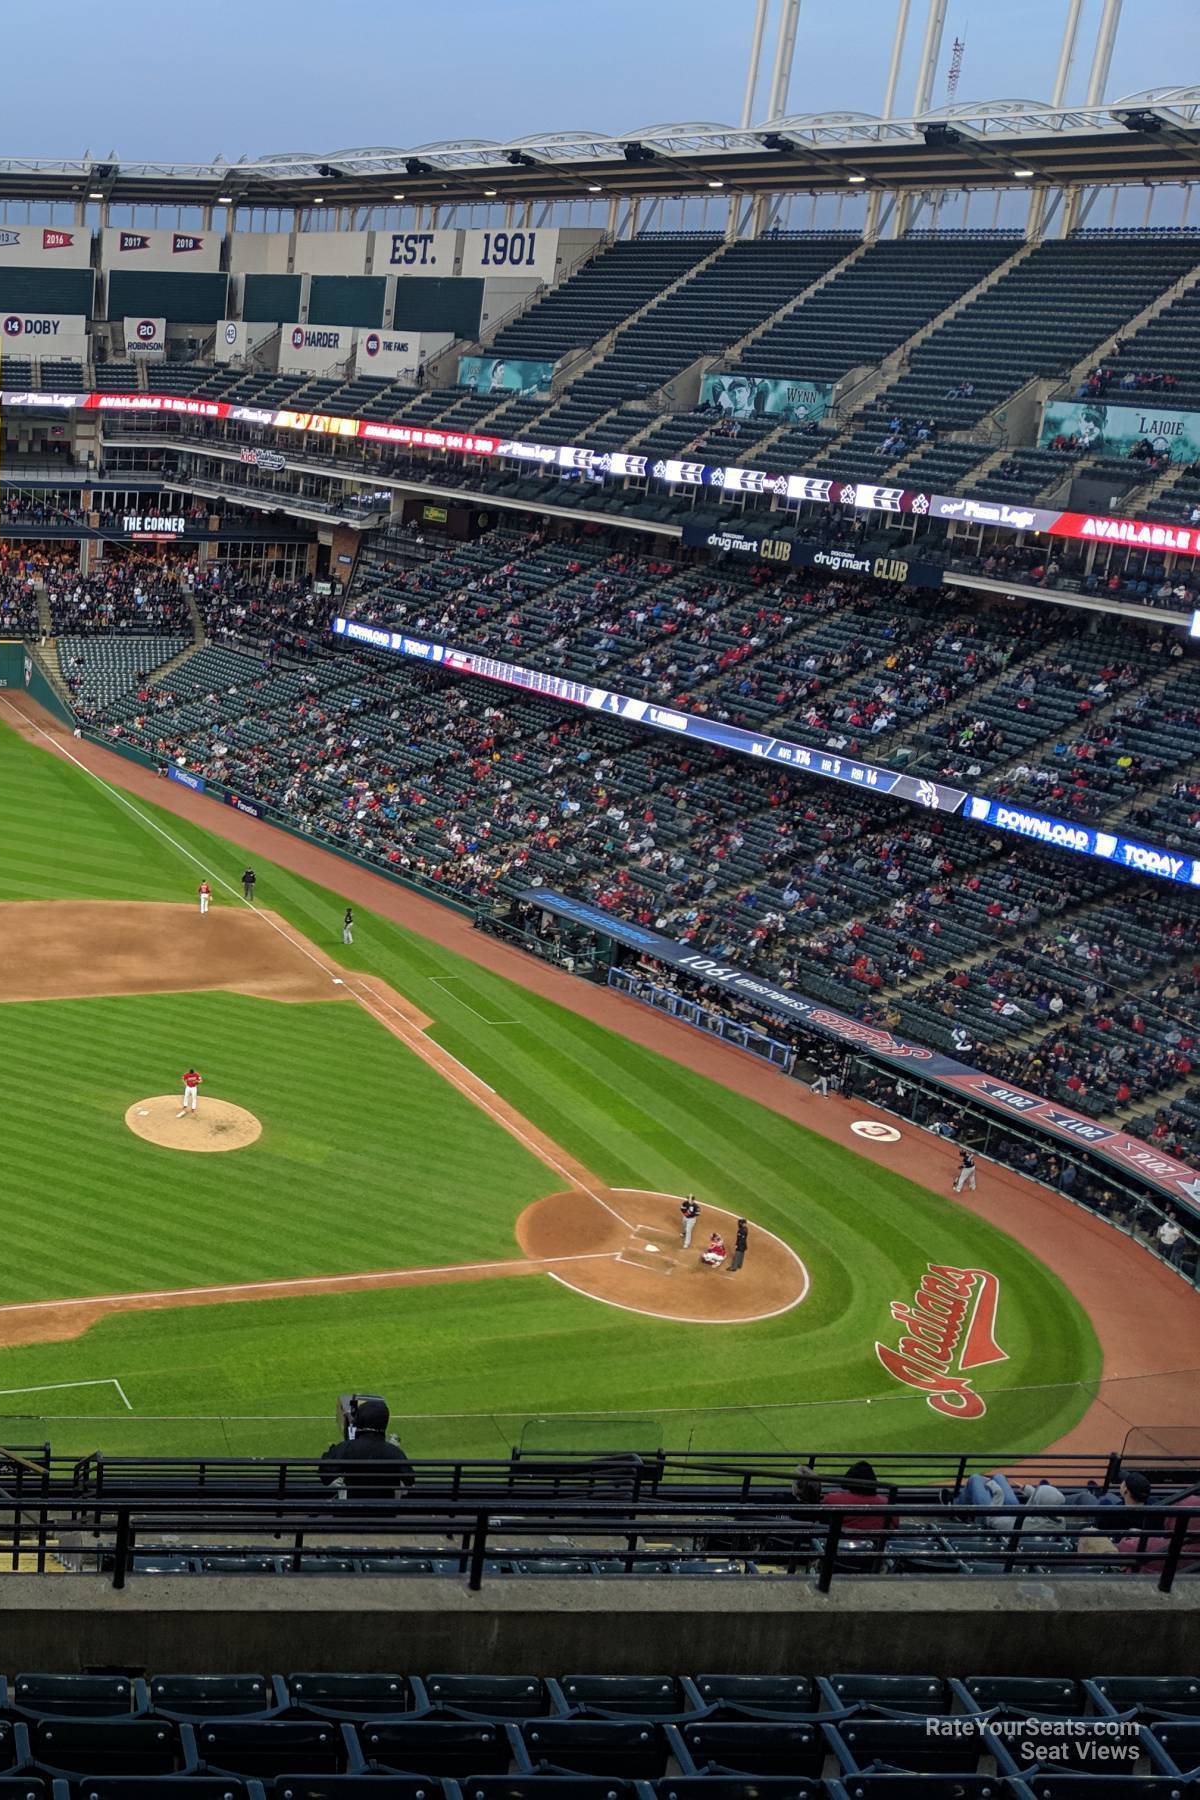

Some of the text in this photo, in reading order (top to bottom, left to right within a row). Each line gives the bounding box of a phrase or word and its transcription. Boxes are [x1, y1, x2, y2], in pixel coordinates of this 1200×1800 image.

[46, 234, 64, 245] 2016
[124, 236, 141, 248] 2017
[176, 238, 194, 248] 2018
[390, 234, 436, 264] EST.
[481, 232, 536, 265] 1901
[7, 320, 60, 336] 14 DOBY
[140, 325, 153, 336] 20
[226, 328, 237, 340] 42
[128, 342, 163, 351] ROBINSON
[304, 332, 340, 348] HARDER
[382, 341, 393, 351] THE
[394, 342, 408, 352] FANS
[100, 397, 161, 408] AVAILABLE
[786, 386, 818, 404] WYNN
[1139, 417, 1185, 436] LAJOIE
[123, 516, 185, 532] THE CORNER
[1080, 518, 1190, 549] AVAILABLE
[708, 533, 792, 561] drug mart CLUB
[814, 551, 908, 582] drug mart CLUB
[997, 808, 1184, 874] DOWNLOAD TODAY
[678, 955, 742, 981] 1901
[735, 978, 810, 1011] ESTABLISHED
[991, 1088, 1035, 1108] 2018
[1061, 1118, 1106, 1138] 2017
[1129, 1152, 1176, 1174] 2016
[875, 1262, 1010, 1419] Indians
